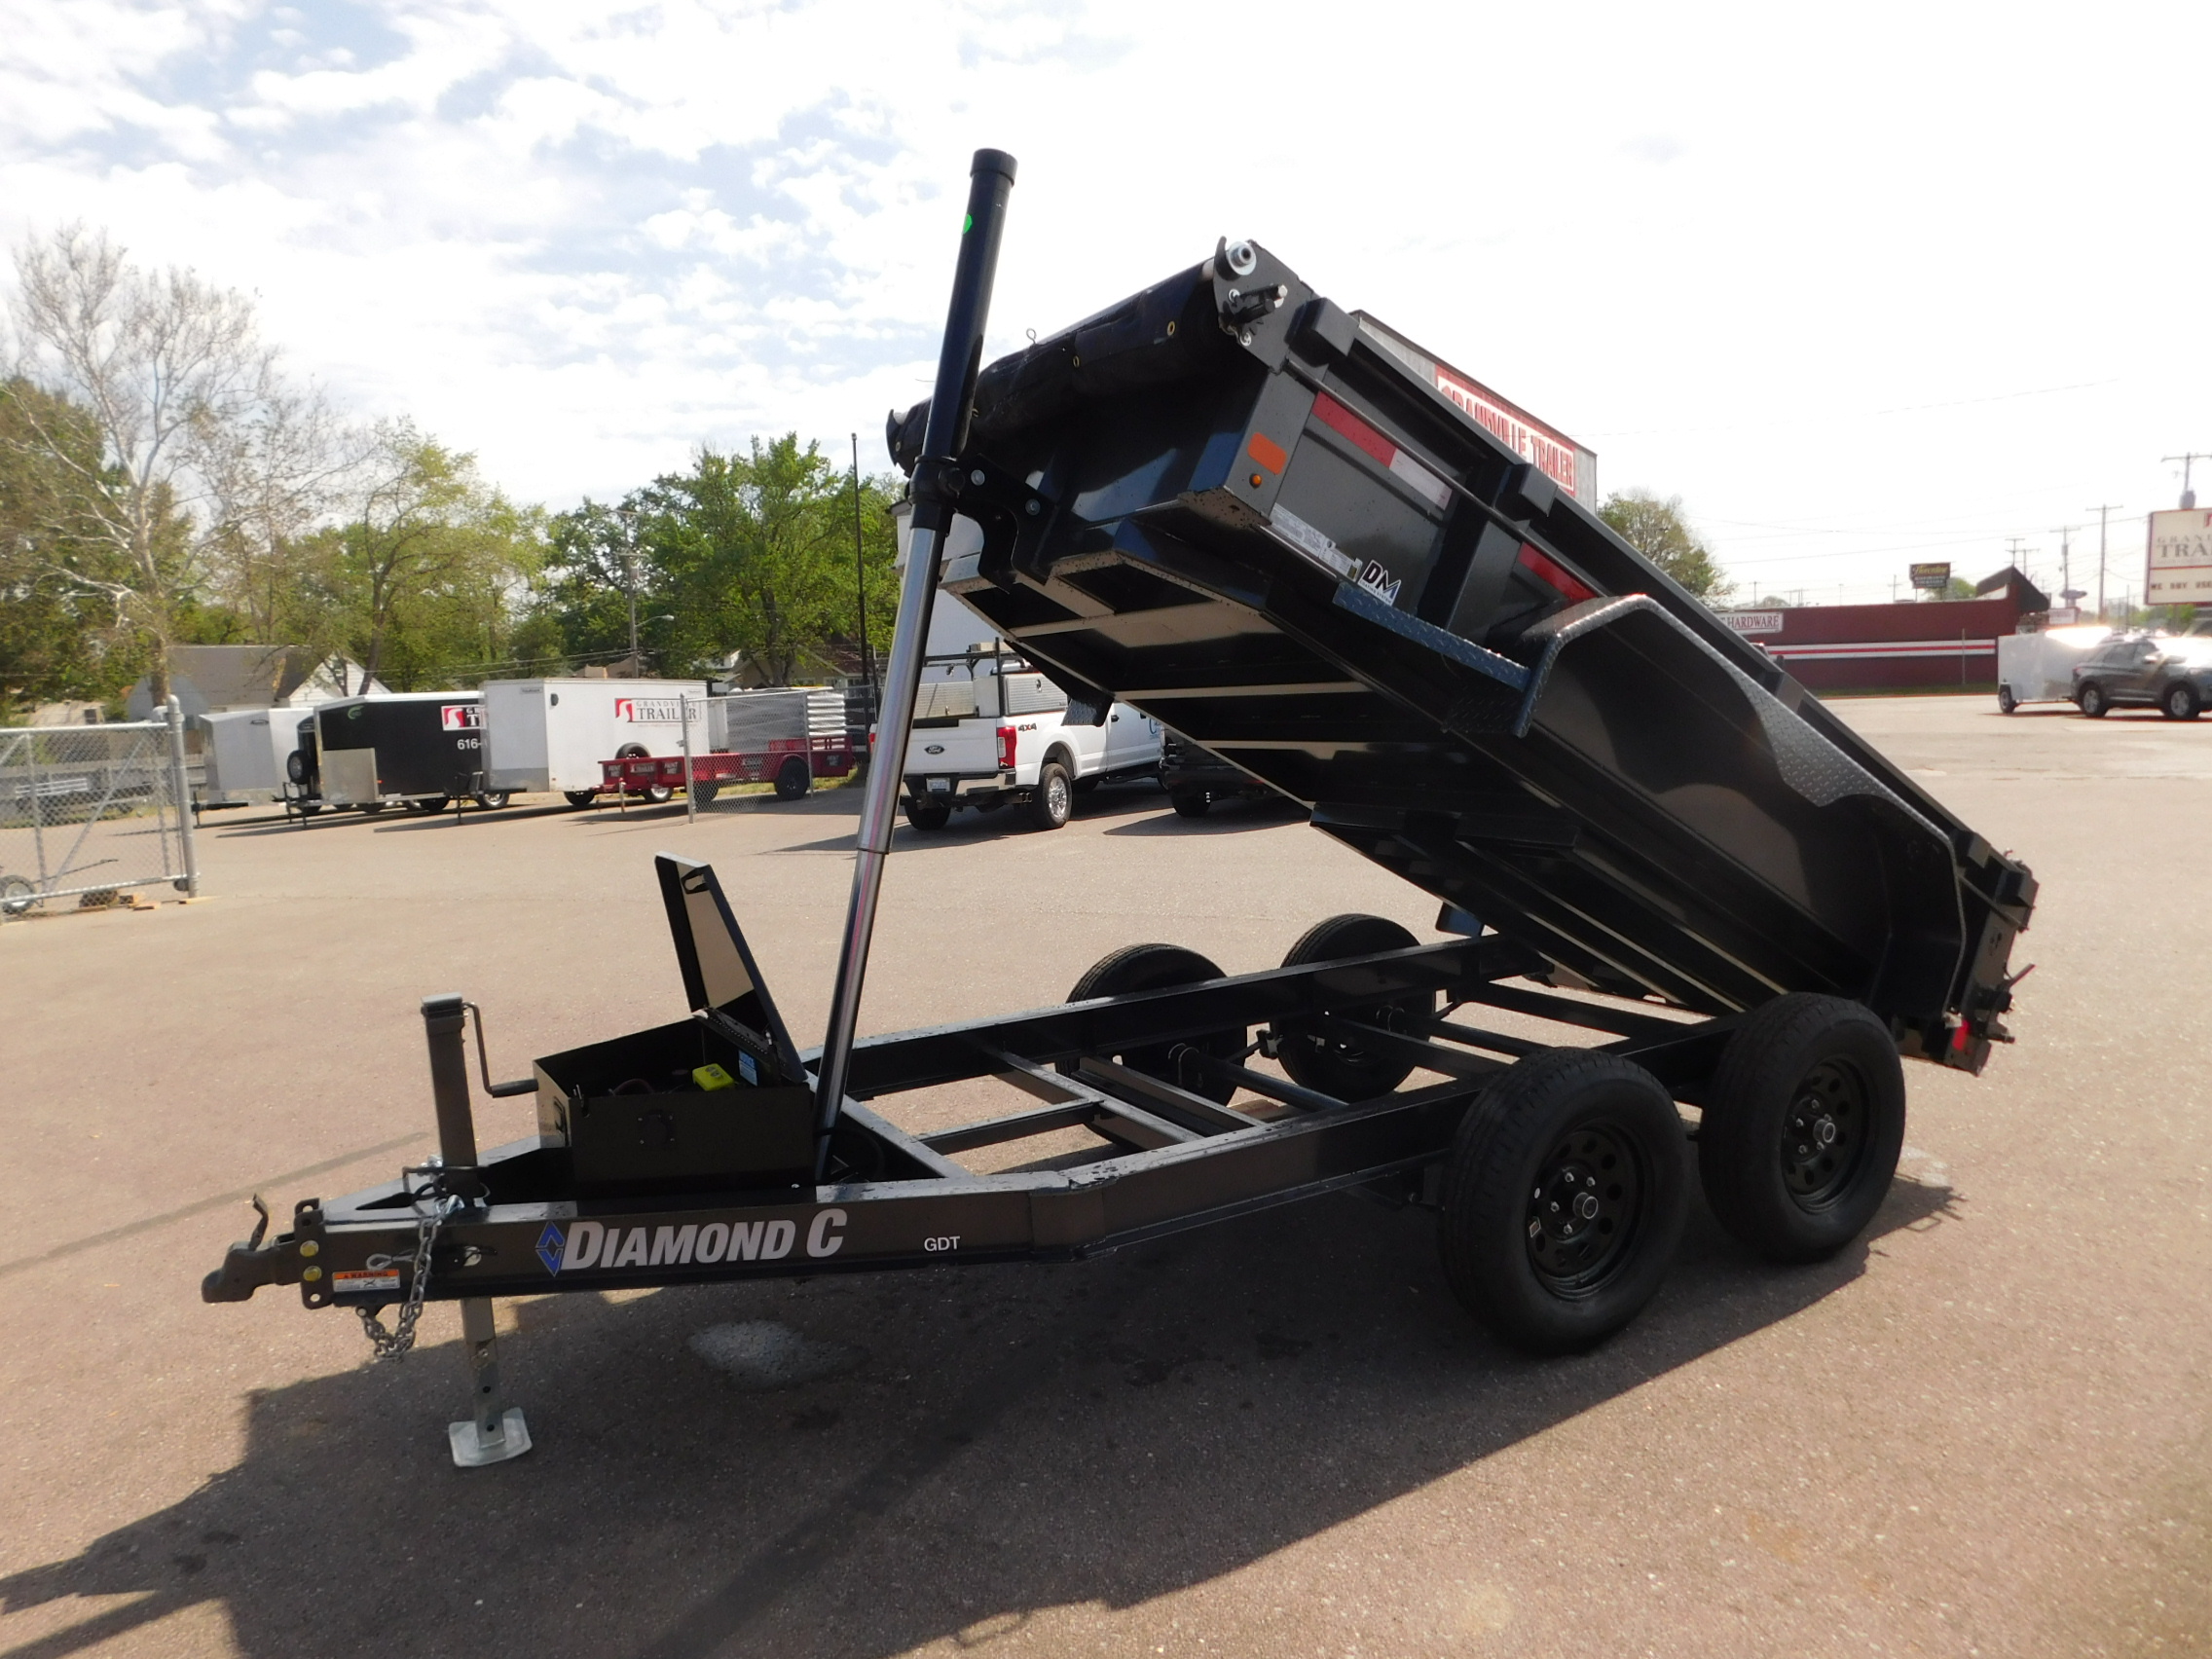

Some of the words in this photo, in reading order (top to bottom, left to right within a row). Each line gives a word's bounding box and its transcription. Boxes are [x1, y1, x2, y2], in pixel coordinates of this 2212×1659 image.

[1530, 434, 1572, 488] TRAILER
[1361, 562, 1400, 600] DM
[1726, 615, 1780, 629] HARDWARE
[637, 708, 697, 720] TRAILR
[560, 1220, 796, 1271] DIAMOND
[806, 1208, 848, 1258] C
[924, 1235, 961, 1252] GDT
